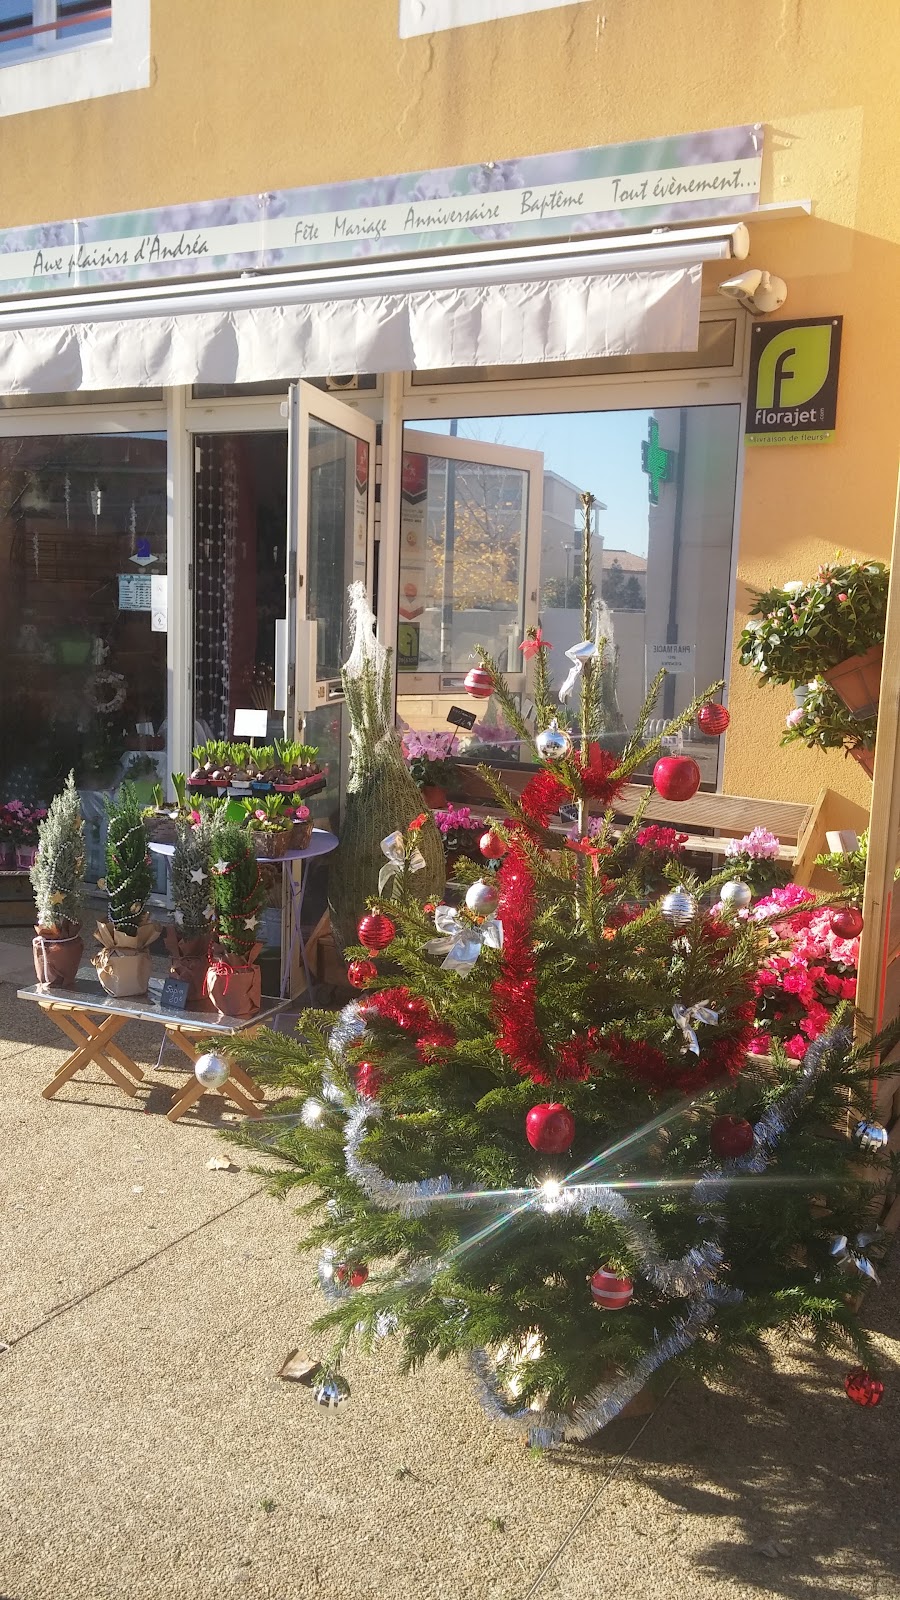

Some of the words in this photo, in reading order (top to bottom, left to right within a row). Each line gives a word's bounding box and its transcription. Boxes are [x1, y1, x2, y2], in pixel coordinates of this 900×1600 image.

[294, 221, 319, 243] Fête
[333, 216, 387, 241] Mariage
[403, 203, 500, 231] Anniversaire
[520, 190, 584, 218] Baptême
[611, 178, 648, 203] Tout
[32, 250, 63, 276] Aux
[67, 245, 129, 277] plaisirs
[133, 234, 209, 262] d'Andréa
[754, 408, 817, 427] florajet
[788, 434, 799, 442] de
[801, 433, 824, 441] fleurs
